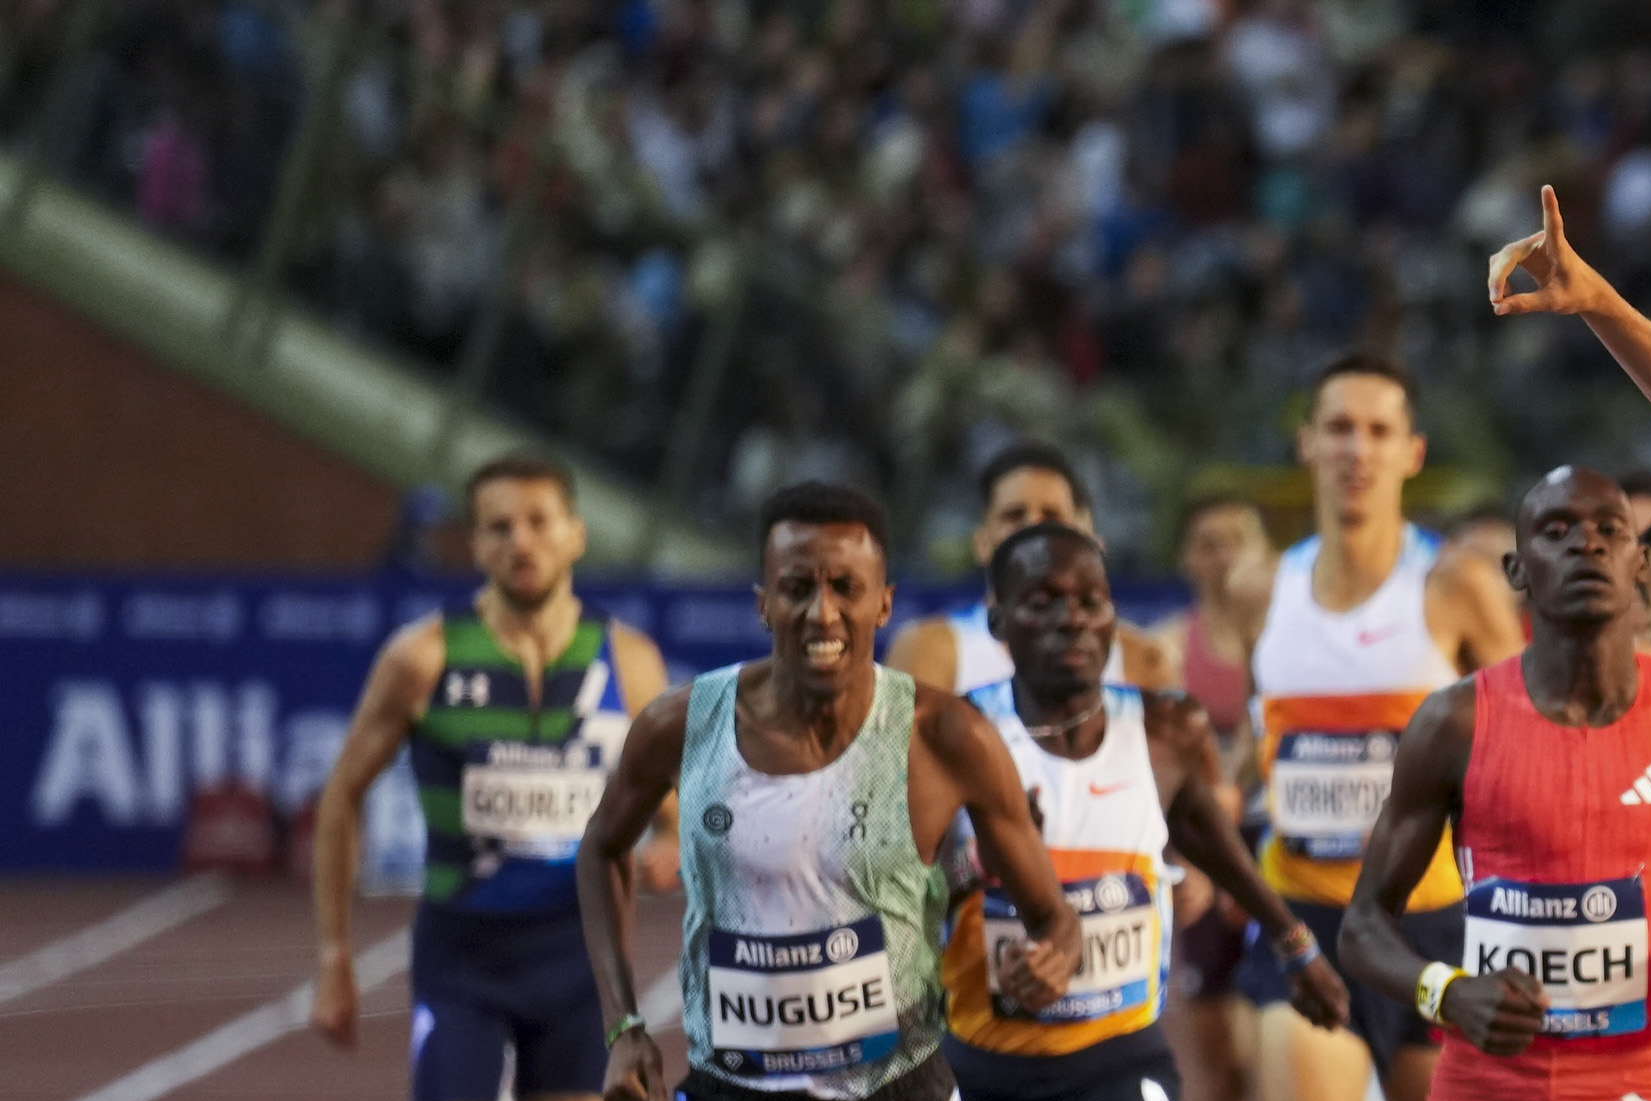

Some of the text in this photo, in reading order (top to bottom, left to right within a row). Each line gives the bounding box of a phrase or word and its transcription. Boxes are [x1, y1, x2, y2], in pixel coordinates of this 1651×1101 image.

[1490, 887, 1578, 919] Allianz
[734, 939, 822, 968] Allianz
[1479, 943, 1633, 985] KOECH
[719, 976, 885, 1026] NUGUSE
[762, 1044, 863, 1070] BRUSSELS
